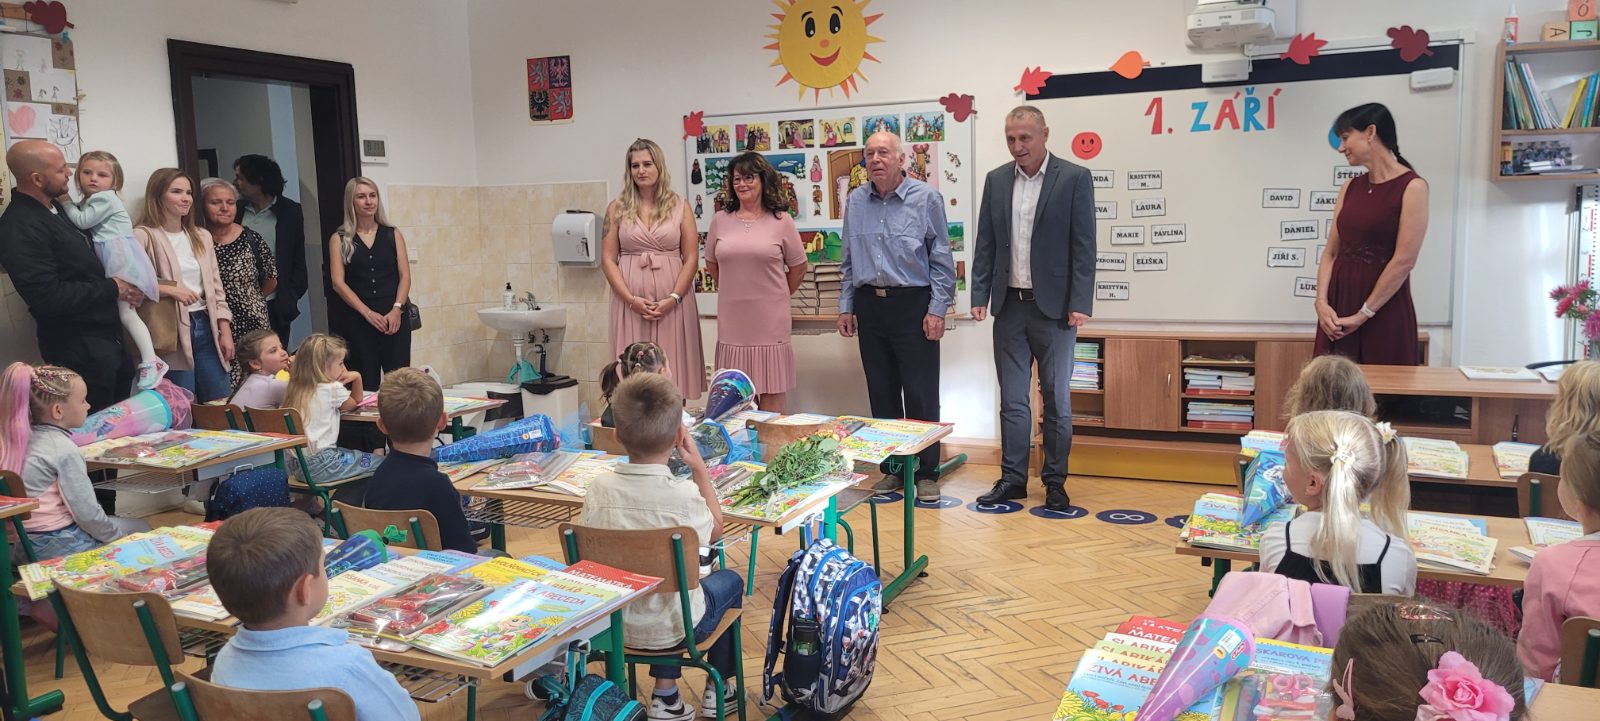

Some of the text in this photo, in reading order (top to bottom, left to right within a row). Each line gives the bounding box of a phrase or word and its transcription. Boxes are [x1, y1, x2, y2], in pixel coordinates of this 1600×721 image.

[1144, 87, 1282, 135] 1. ZÁŘÍ
[1284, 226, 1315, 234] DANIEL
[1136, 256, 1164, 264] ELIŠKA
[1300, 282, 1317, 291] LUK
[1109, 513, 1144, 521] 8
